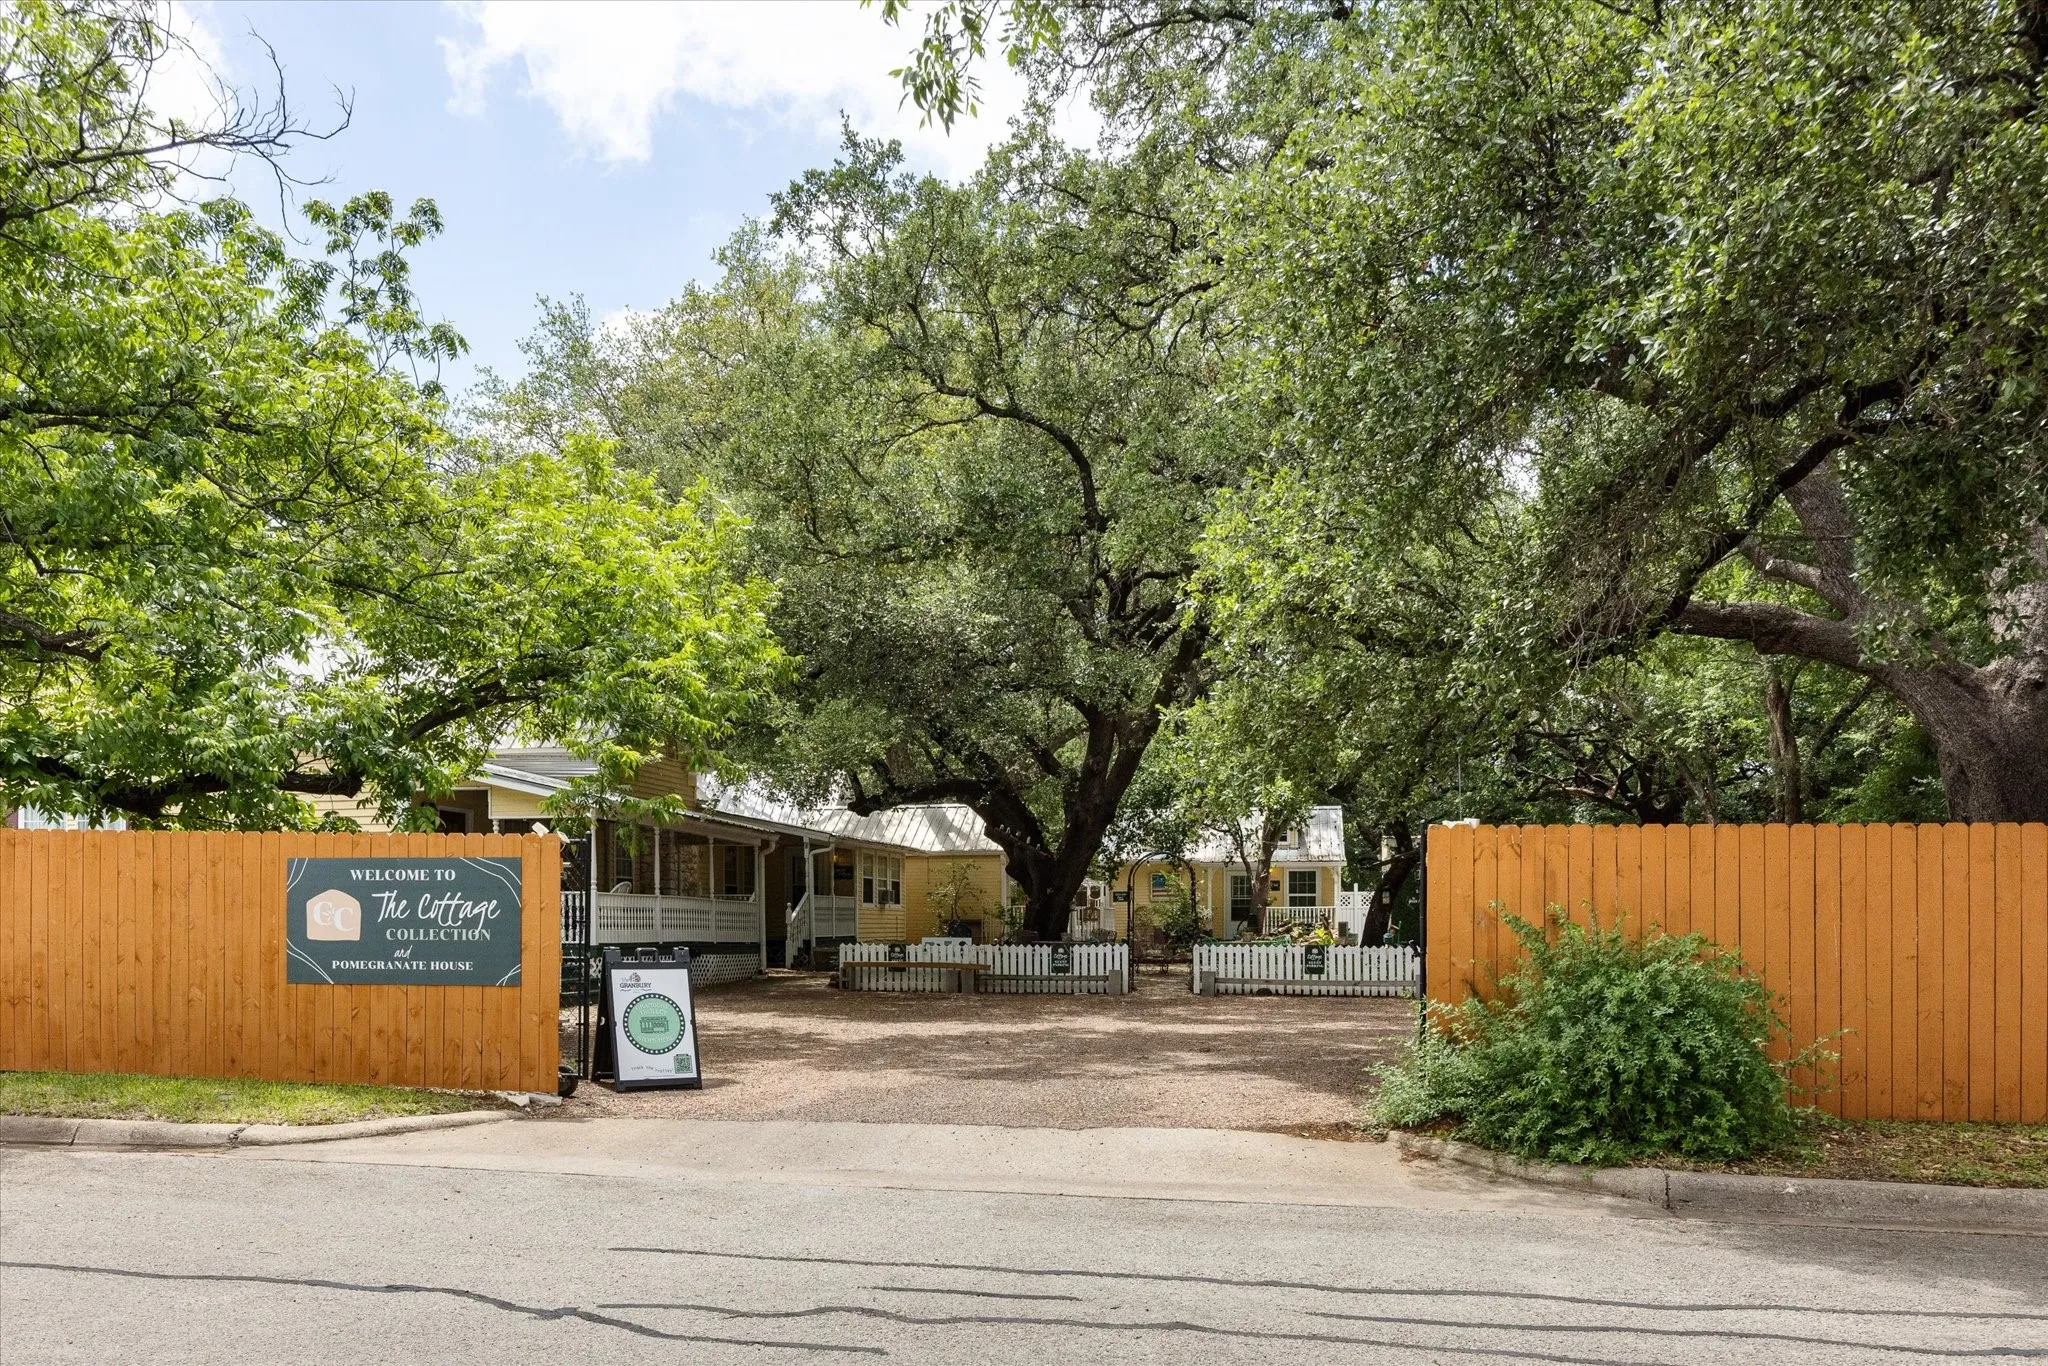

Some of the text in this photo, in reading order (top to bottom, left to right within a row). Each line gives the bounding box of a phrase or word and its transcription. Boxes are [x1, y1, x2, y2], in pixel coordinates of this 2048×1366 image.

[350, 869, 456, 881] WELCOME TO
[372, 890, 501, 934] The Cottage
[386, 928, 491, 941] COLLECTION
[394, 945, 413, 959] and
[332, 960, 474, 971] POMEGRANATE HOUSE
